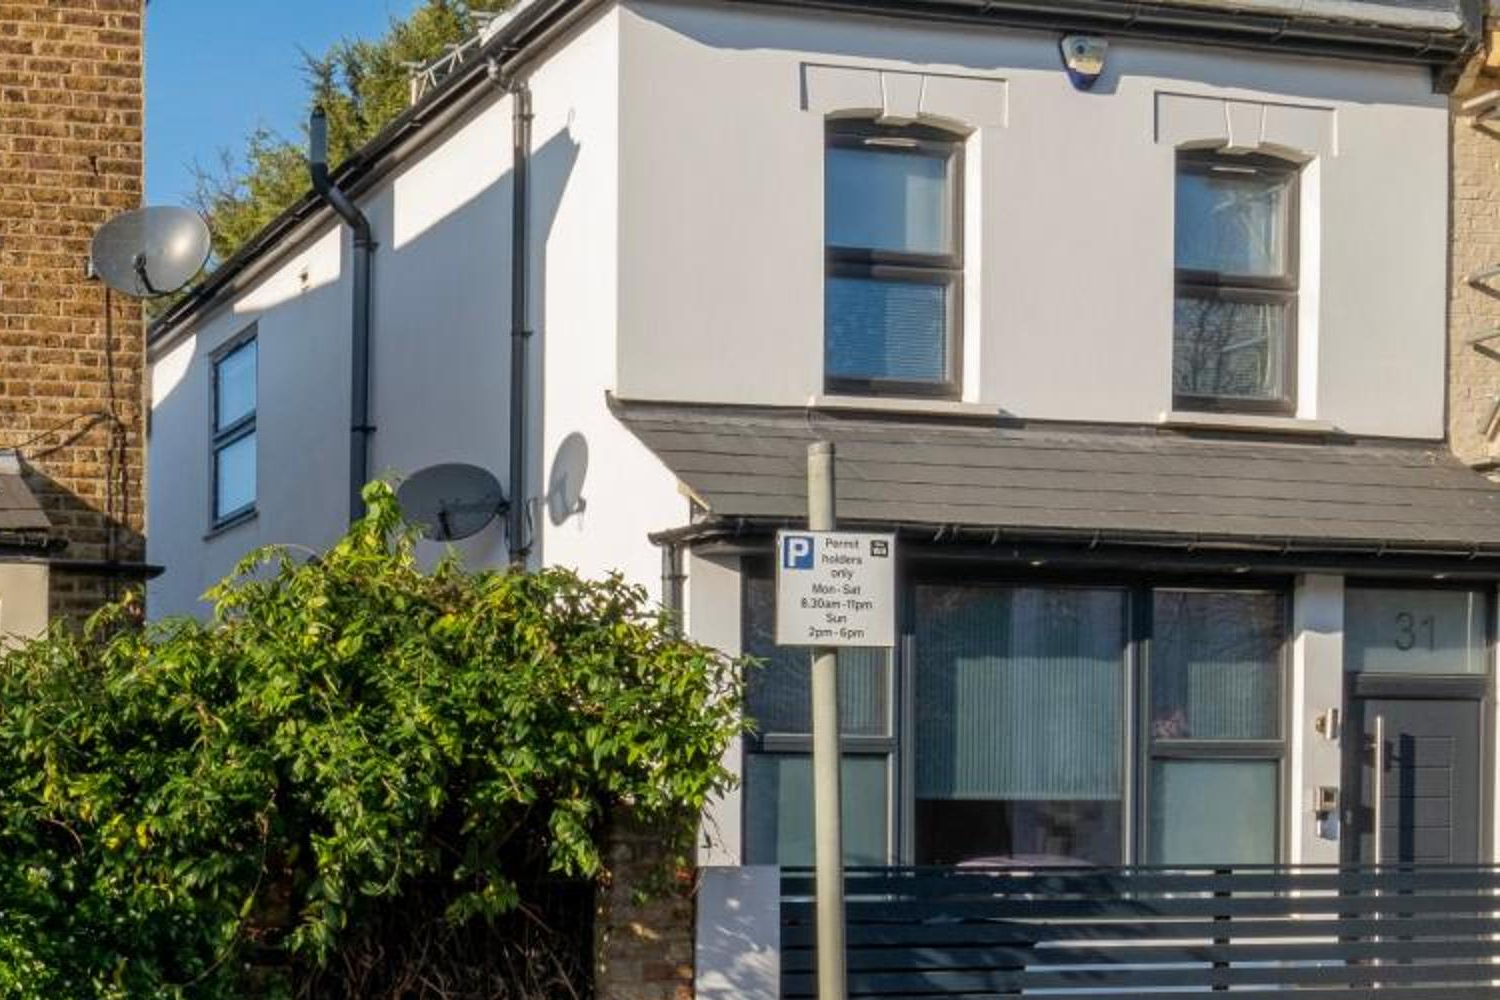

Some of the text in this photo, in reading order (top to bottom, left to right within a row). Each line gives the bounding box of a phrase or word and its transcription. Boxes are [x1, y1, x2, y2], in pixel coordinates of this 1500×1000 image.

[825, 538, 859, 549] Permit
[788, 538, 809, 567] P
[821, 554, 863, 565] holders
[830, 569, 853, 580] only
[825, 613, 847, 623] Sun
[1396, 611, 1435, 652] 31
